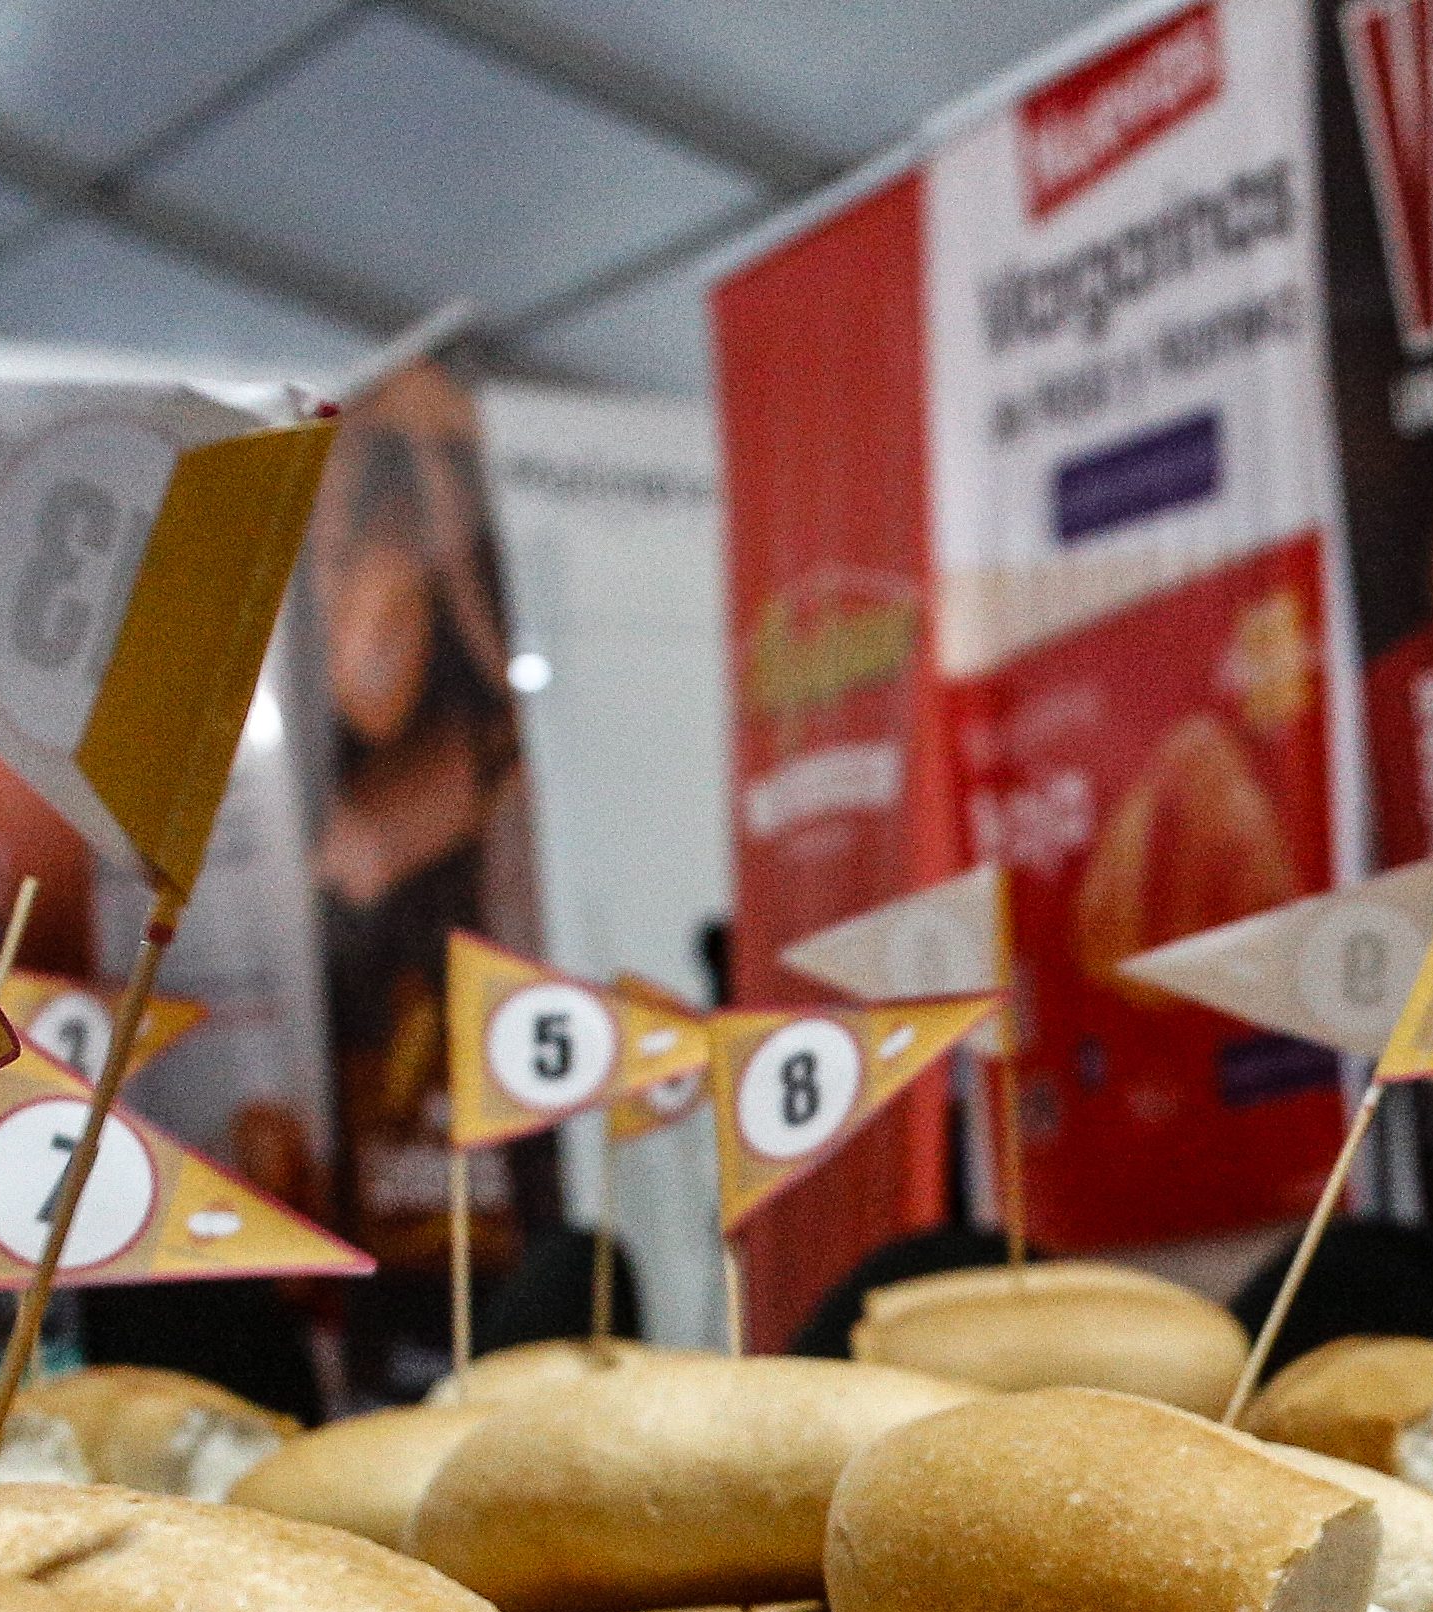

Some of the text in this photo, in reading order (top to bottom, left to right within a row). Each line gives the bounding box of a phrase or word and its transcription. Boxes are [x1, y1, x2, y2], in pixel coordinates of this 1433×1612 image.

[527, 1010, 575, 1082] 5
[777, 1048, 822, 1130] 8
[33, 1130, 91, 1226] 7
